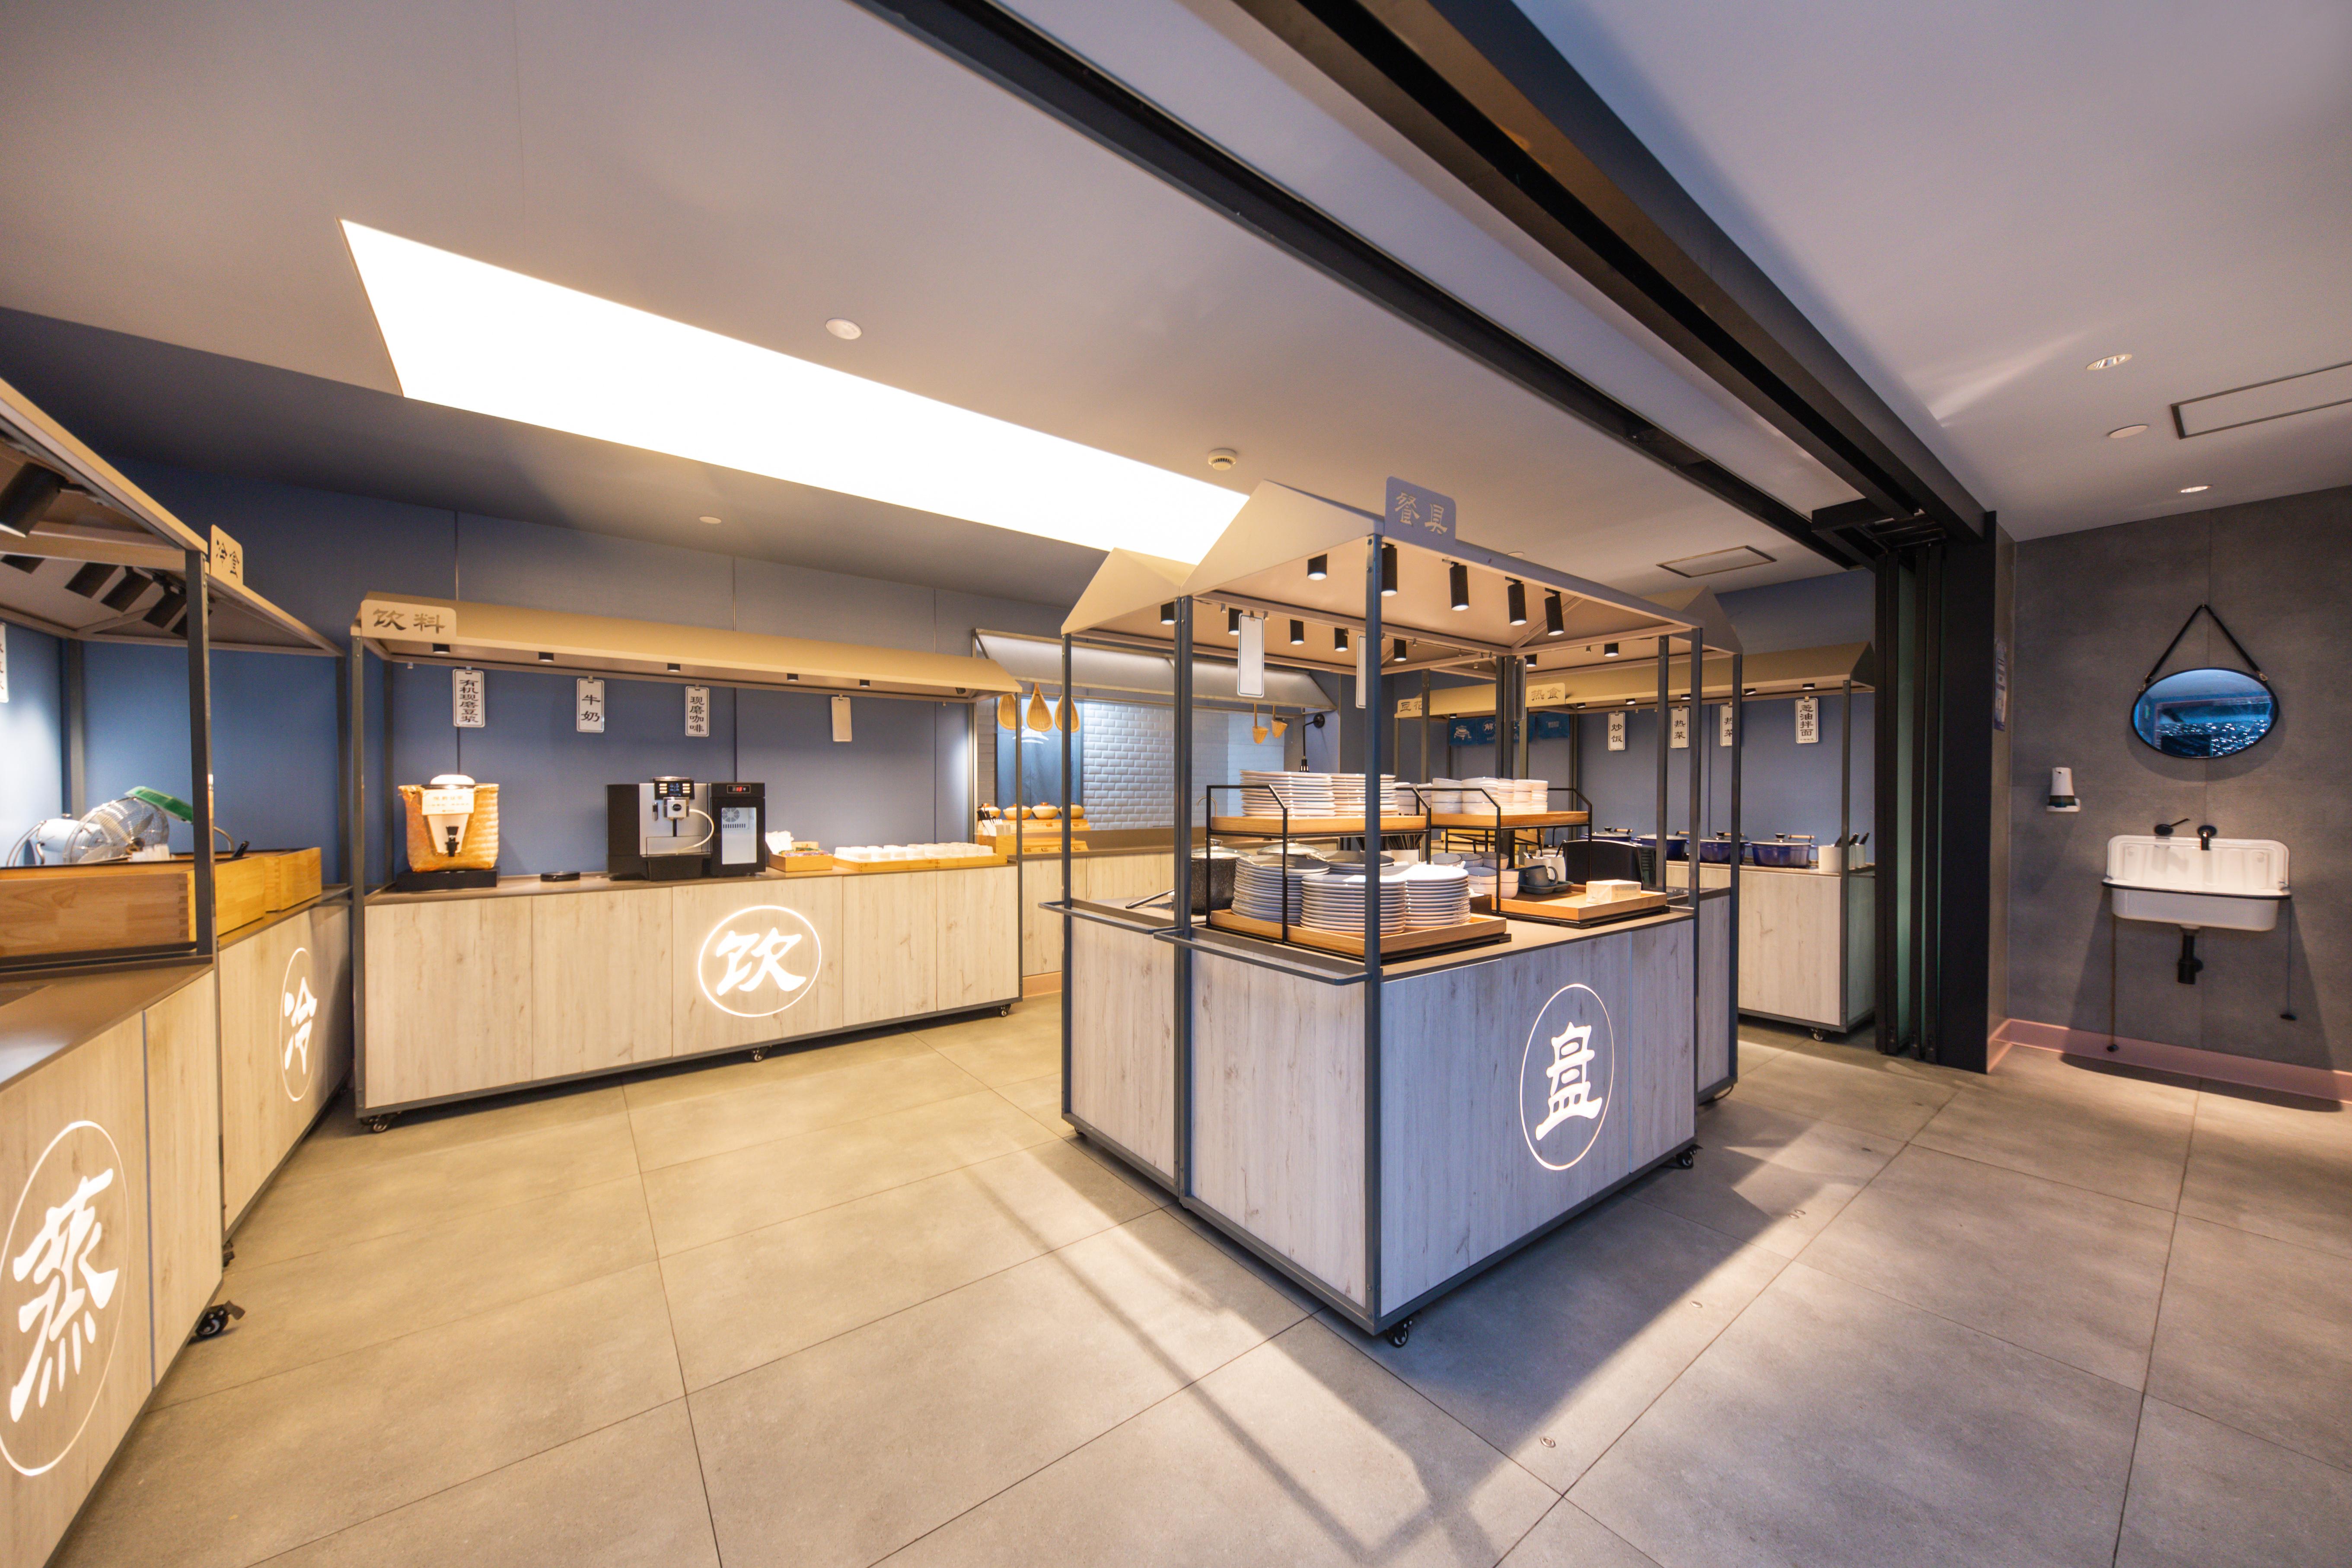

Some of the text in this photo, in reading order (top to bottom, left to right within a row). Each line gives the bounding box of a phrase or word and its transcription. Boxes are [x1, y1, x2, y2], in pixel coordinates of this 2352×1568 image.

[1395, 492, 1447, 534] 餐具
[373, 608, 446, 634] 饮料
[459, 679, 479, 722] 有机现磨豆浆
[581, 694, 601, 722] 牛奶
[1531, 687, 1561, 701] 热食
[689, 696, 704, 732] 现磨咖啡
[1611, 723, 1622, 743] 炒饭
[1674, 720, 1686, 739] 热菜
[716, 927, 806, 996] 饮
[284, 977, 317, 1074] 冷
[1536, 1022, 1603, 1141] 盘
[10, 1168, 118, 1422] 蒸
